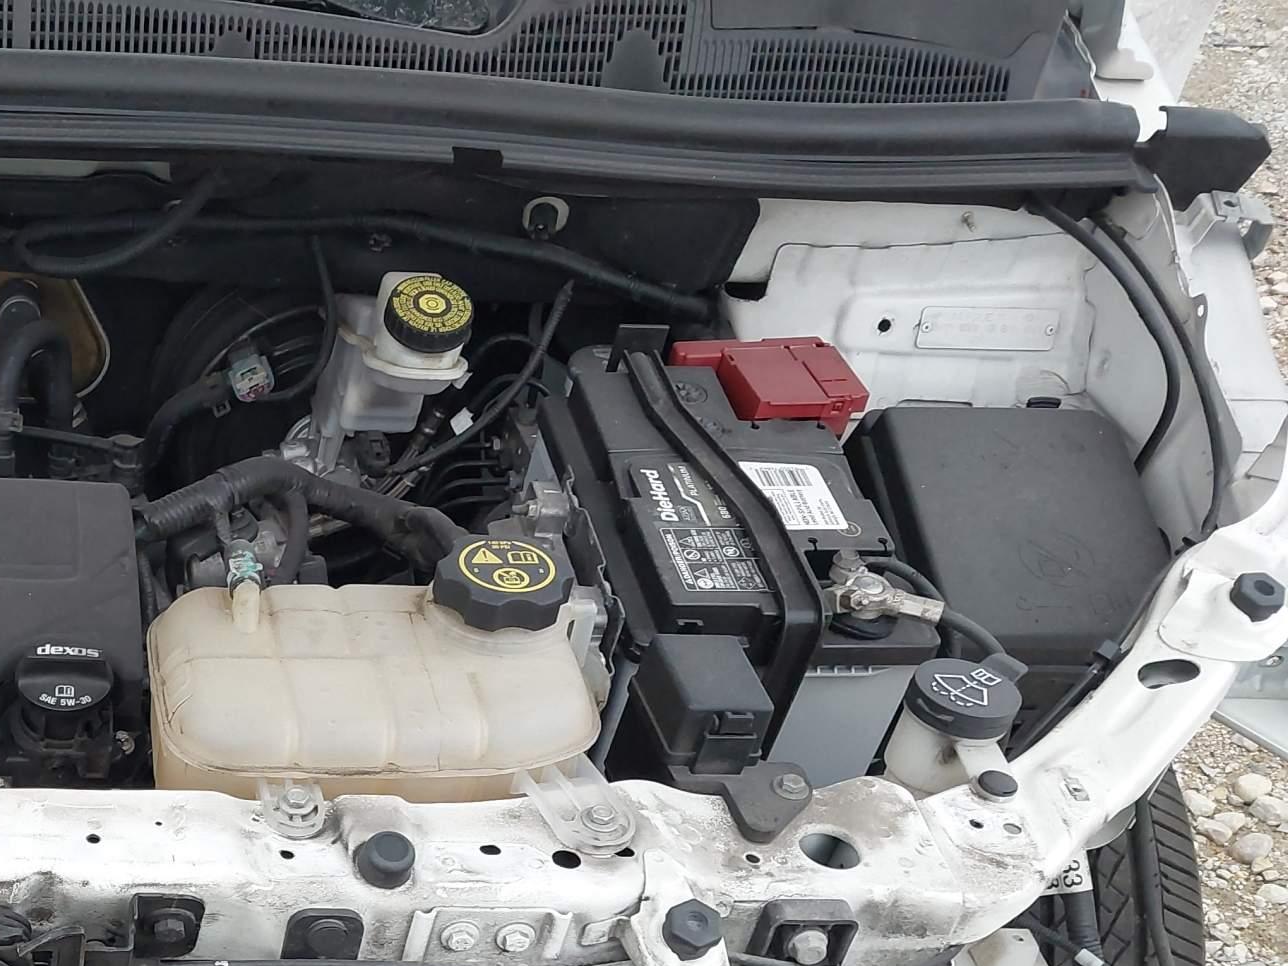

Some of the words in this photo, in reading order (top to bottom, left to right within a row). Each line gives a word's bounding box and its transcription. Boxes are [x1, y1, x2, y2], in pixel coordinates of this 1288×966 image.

[678, 465, 699, 497] PLATINUM
[639, 468, 680, 522] DieHard
[37, 644, 100, 658] dexos
[39, 693, 58, 705] SAE
[60, 695, 92, 707] 5W-30
